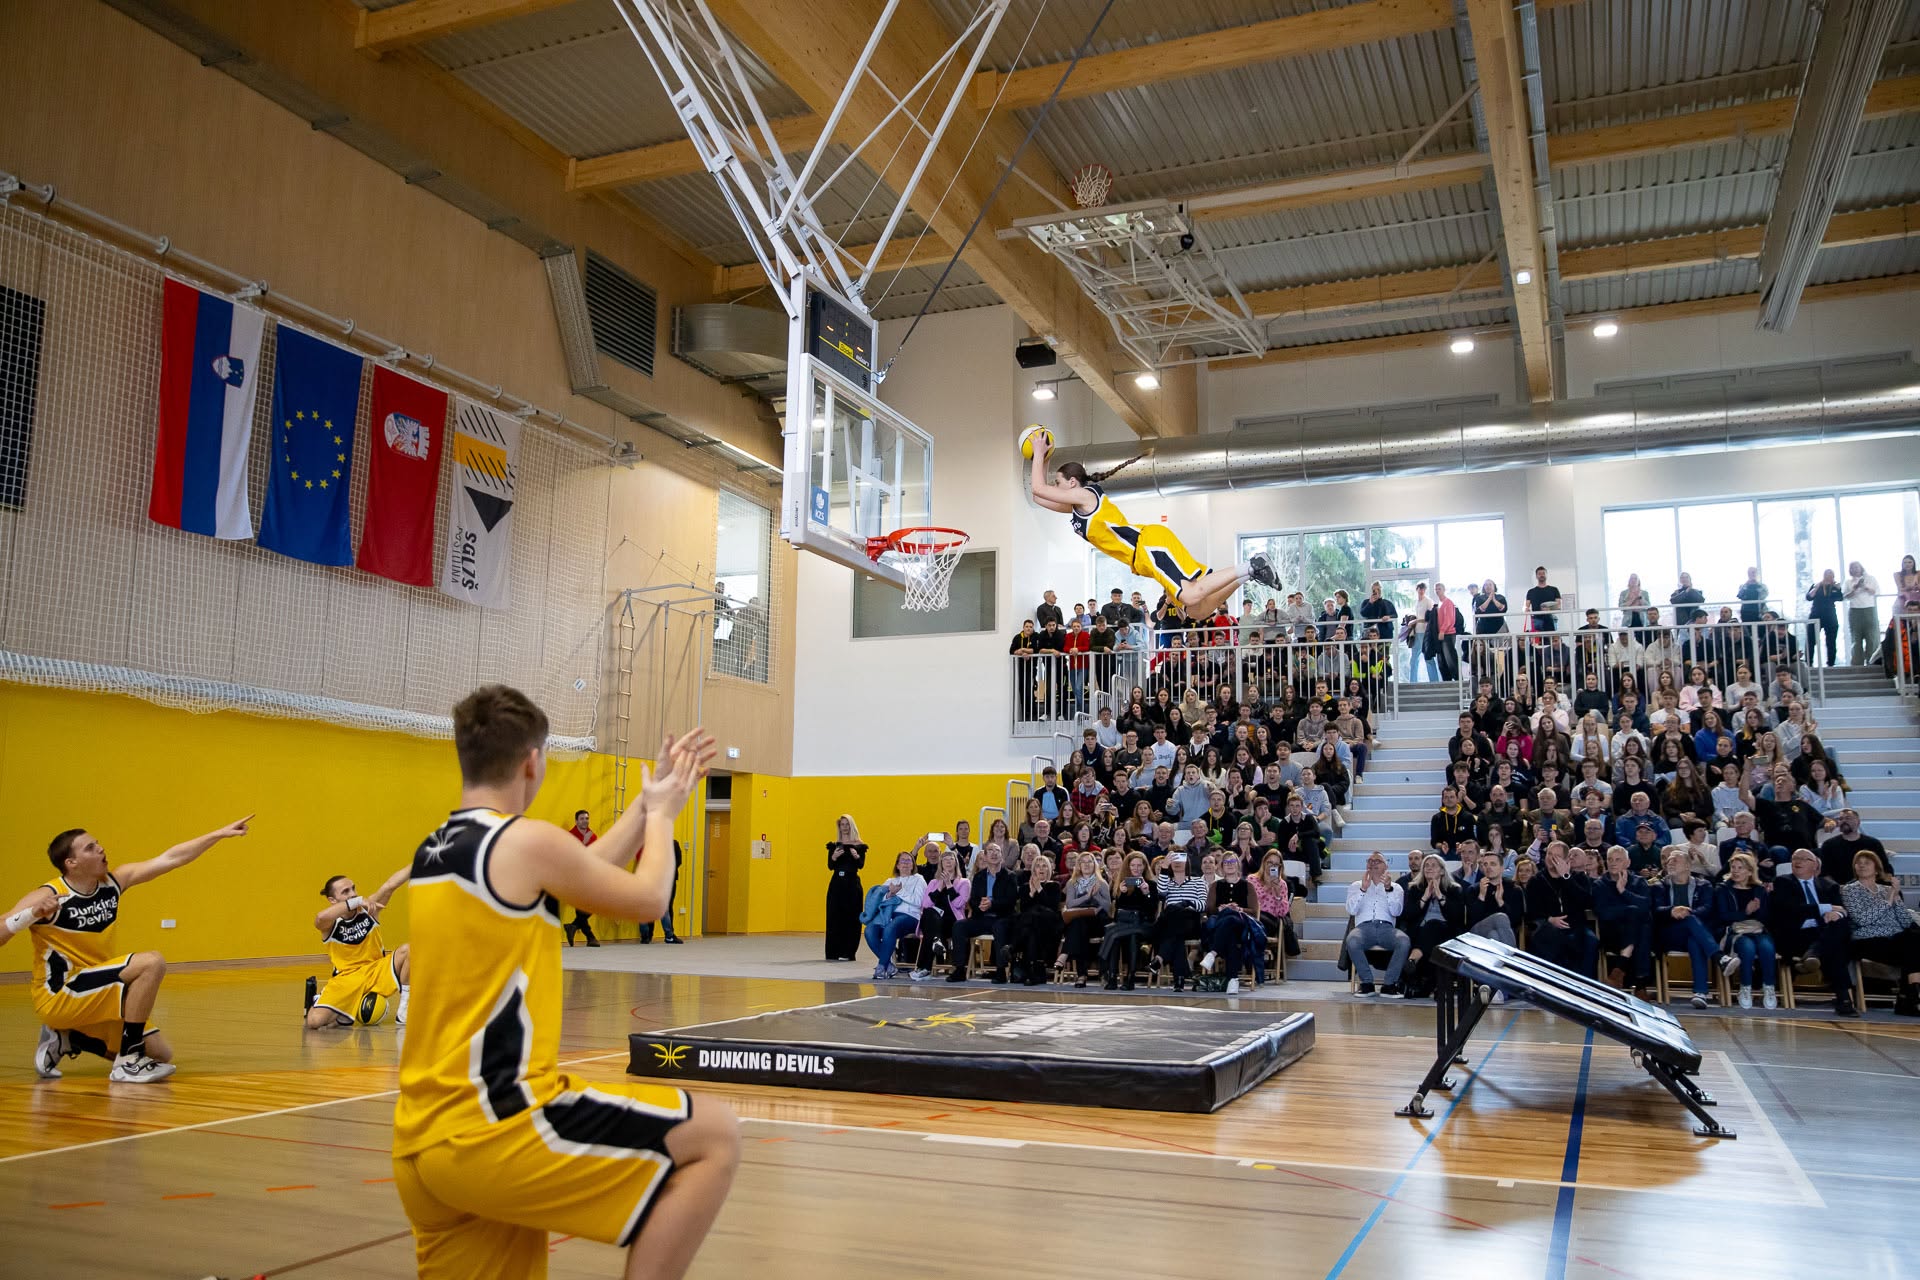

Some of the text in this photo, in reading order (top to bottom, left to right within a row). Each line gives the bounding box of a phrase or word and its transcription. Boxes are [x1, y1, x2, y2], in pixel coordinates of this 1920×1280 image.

[1167, 607, 1177, 617] 10
[67, 895, 118, 919] Dunking
[76, 909, 113, 929] Devils
[342, 928, 368, 942] Devils
[698, 1049, 835, 1075] DUNKING DEVILS
